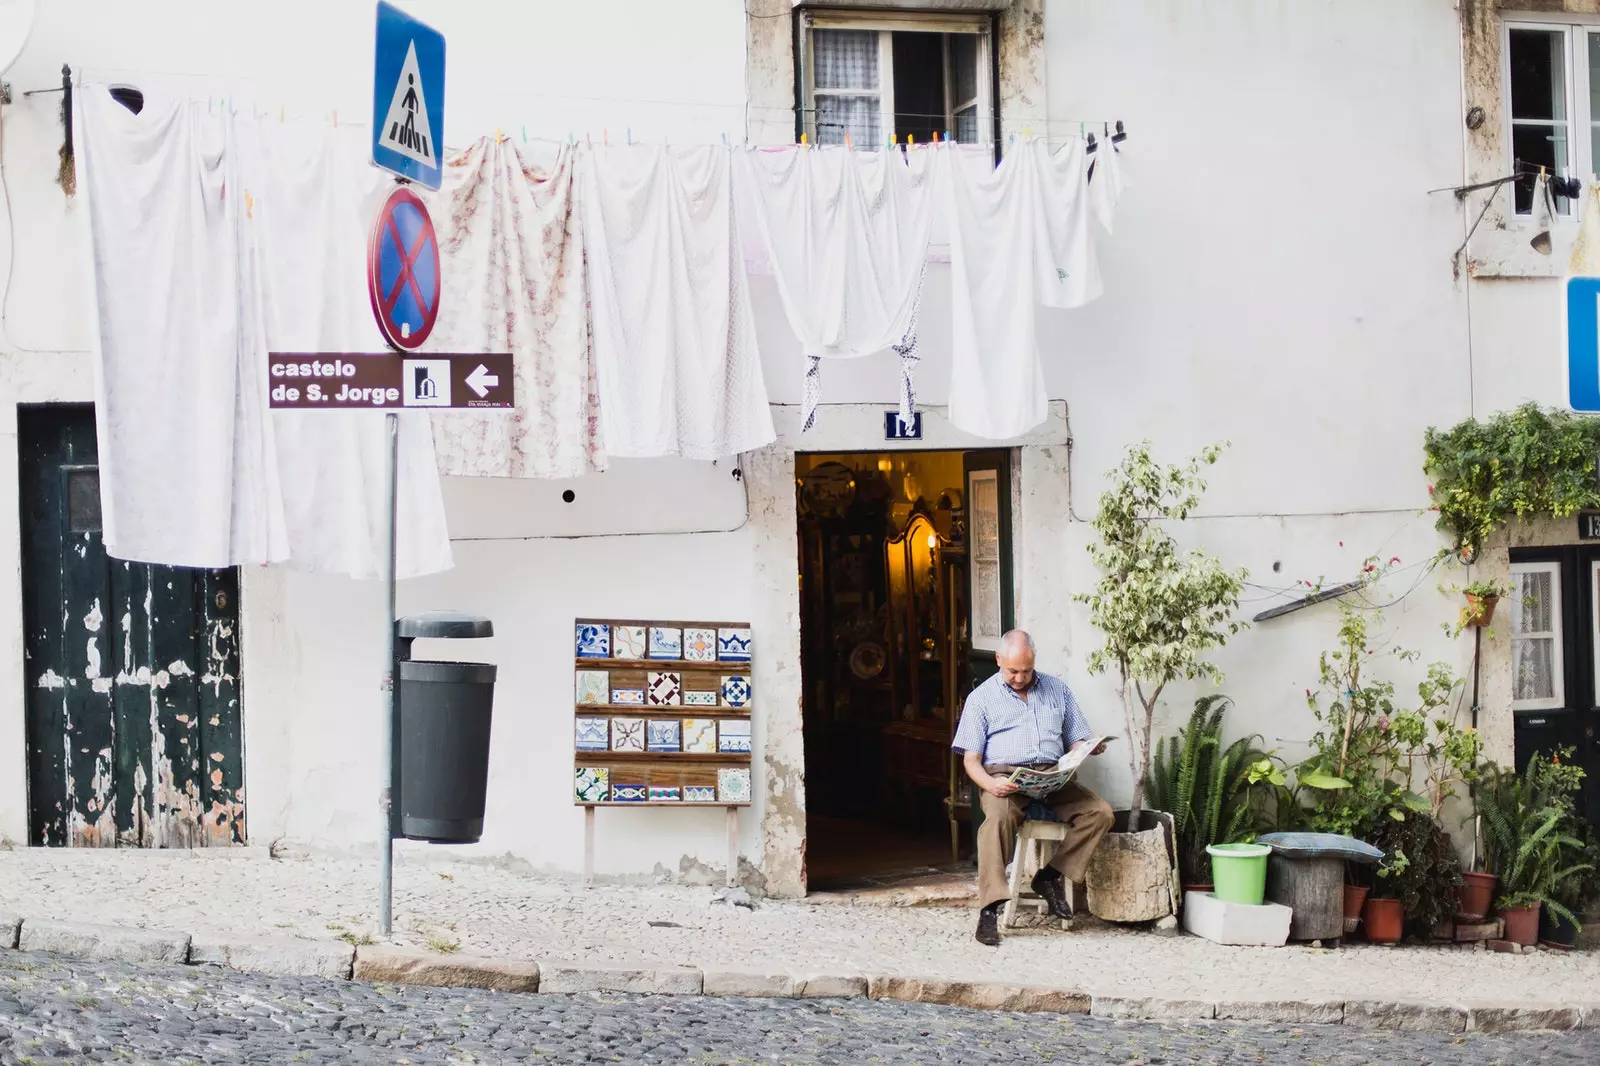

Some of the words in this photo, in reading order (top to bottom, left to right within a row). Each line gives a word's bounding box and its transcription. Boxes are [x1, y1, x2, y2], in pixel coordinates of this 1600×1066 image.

[271, 359, 356, 376] castelo
[271, 384, 299, 401] de
[306, 384, 329, 401] S.
[335, 384, 399, 404] Jorge
